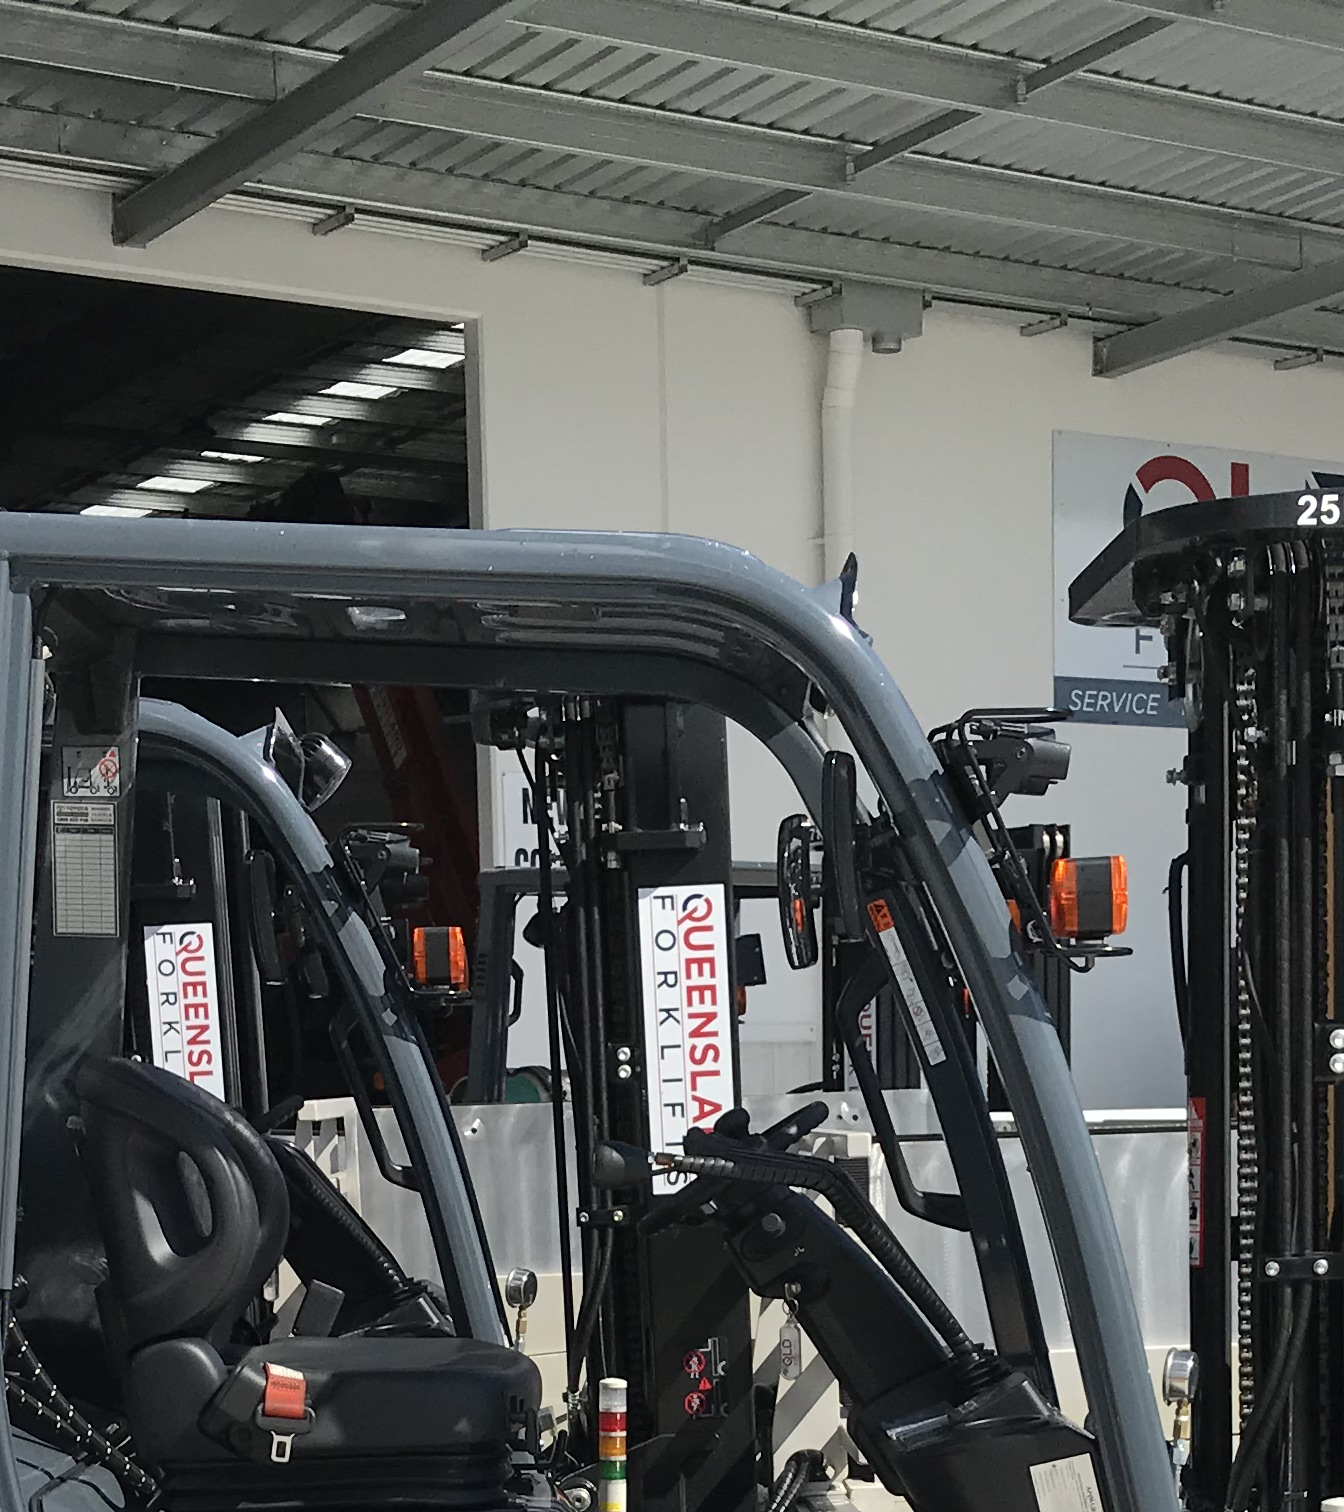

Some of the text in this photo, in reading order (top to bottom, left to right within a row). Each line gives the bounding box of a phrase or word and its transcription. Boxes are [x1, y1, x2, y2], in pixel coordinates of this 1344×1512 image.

[1069, 689, 1161, 716] SERVICE
[156, 932, 181, 1062] FORKL
[176, 931, 213, 1084] QUEENSL
[677, 893, 723, 1134] QUEENSLA
